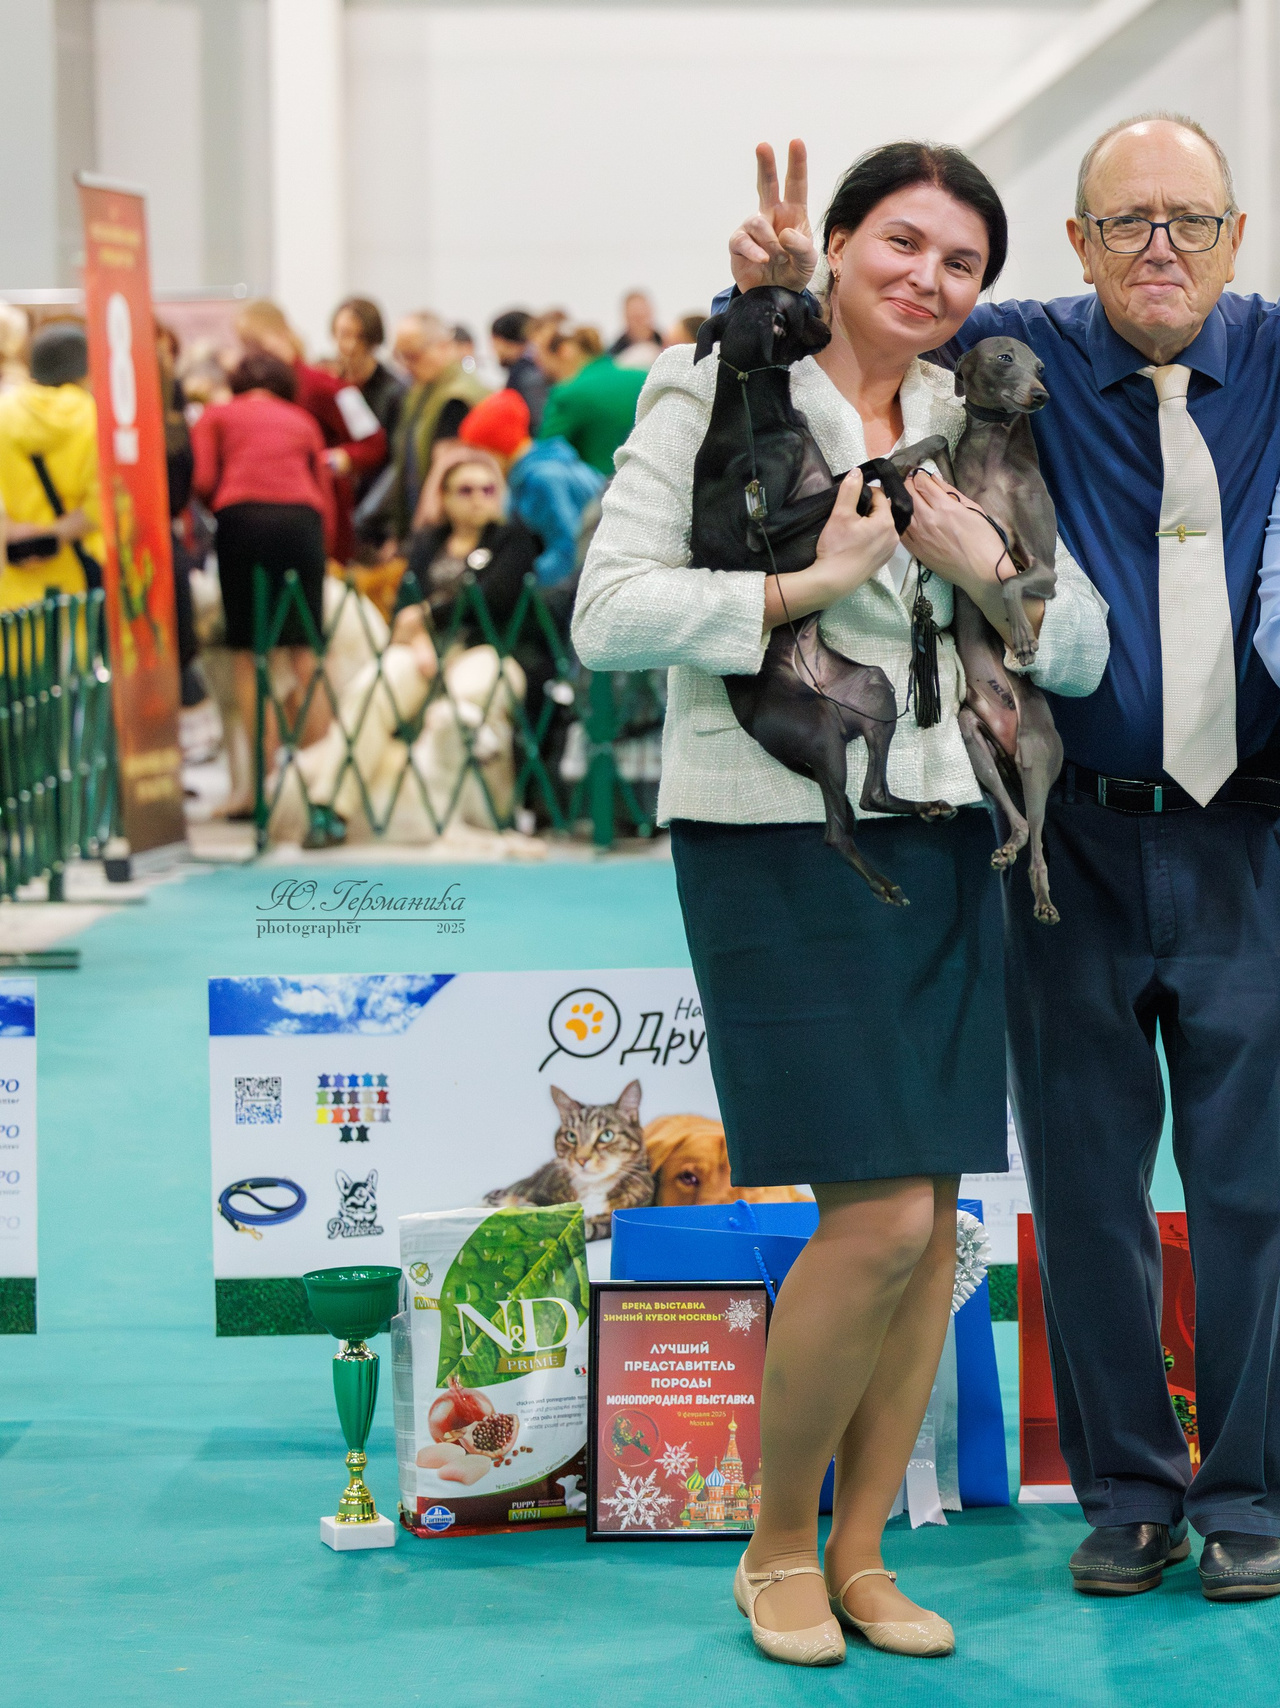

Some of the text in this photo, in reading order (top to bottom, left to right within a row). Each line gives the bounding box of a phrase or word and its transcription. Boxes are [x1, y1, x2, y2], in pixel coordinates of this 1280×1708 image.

[622, 1302, 706, 1310] БРЕНД ВЫСТАВКА
[603, 1312, 643, 1321] ЗИМНИЙ
[454, 1297, 579, 1356] N&D
[650, 1341, 709, 1354] ЛУЧШИЙ
[508, 1355, 559, 1370] PRIME
[624, 1361, 735, 1372] ПРЕДСТАВИТЕЛЬ
[651, 1378, 712, 1388] ПОРОДЫ
[606, 1394, 755, 1406] МОНОПОРОДНАЯ ВЫСТАВКА
[512, 1501, 536, 1509] PUPPY
[512, 1510, 541, 1519] MINI
